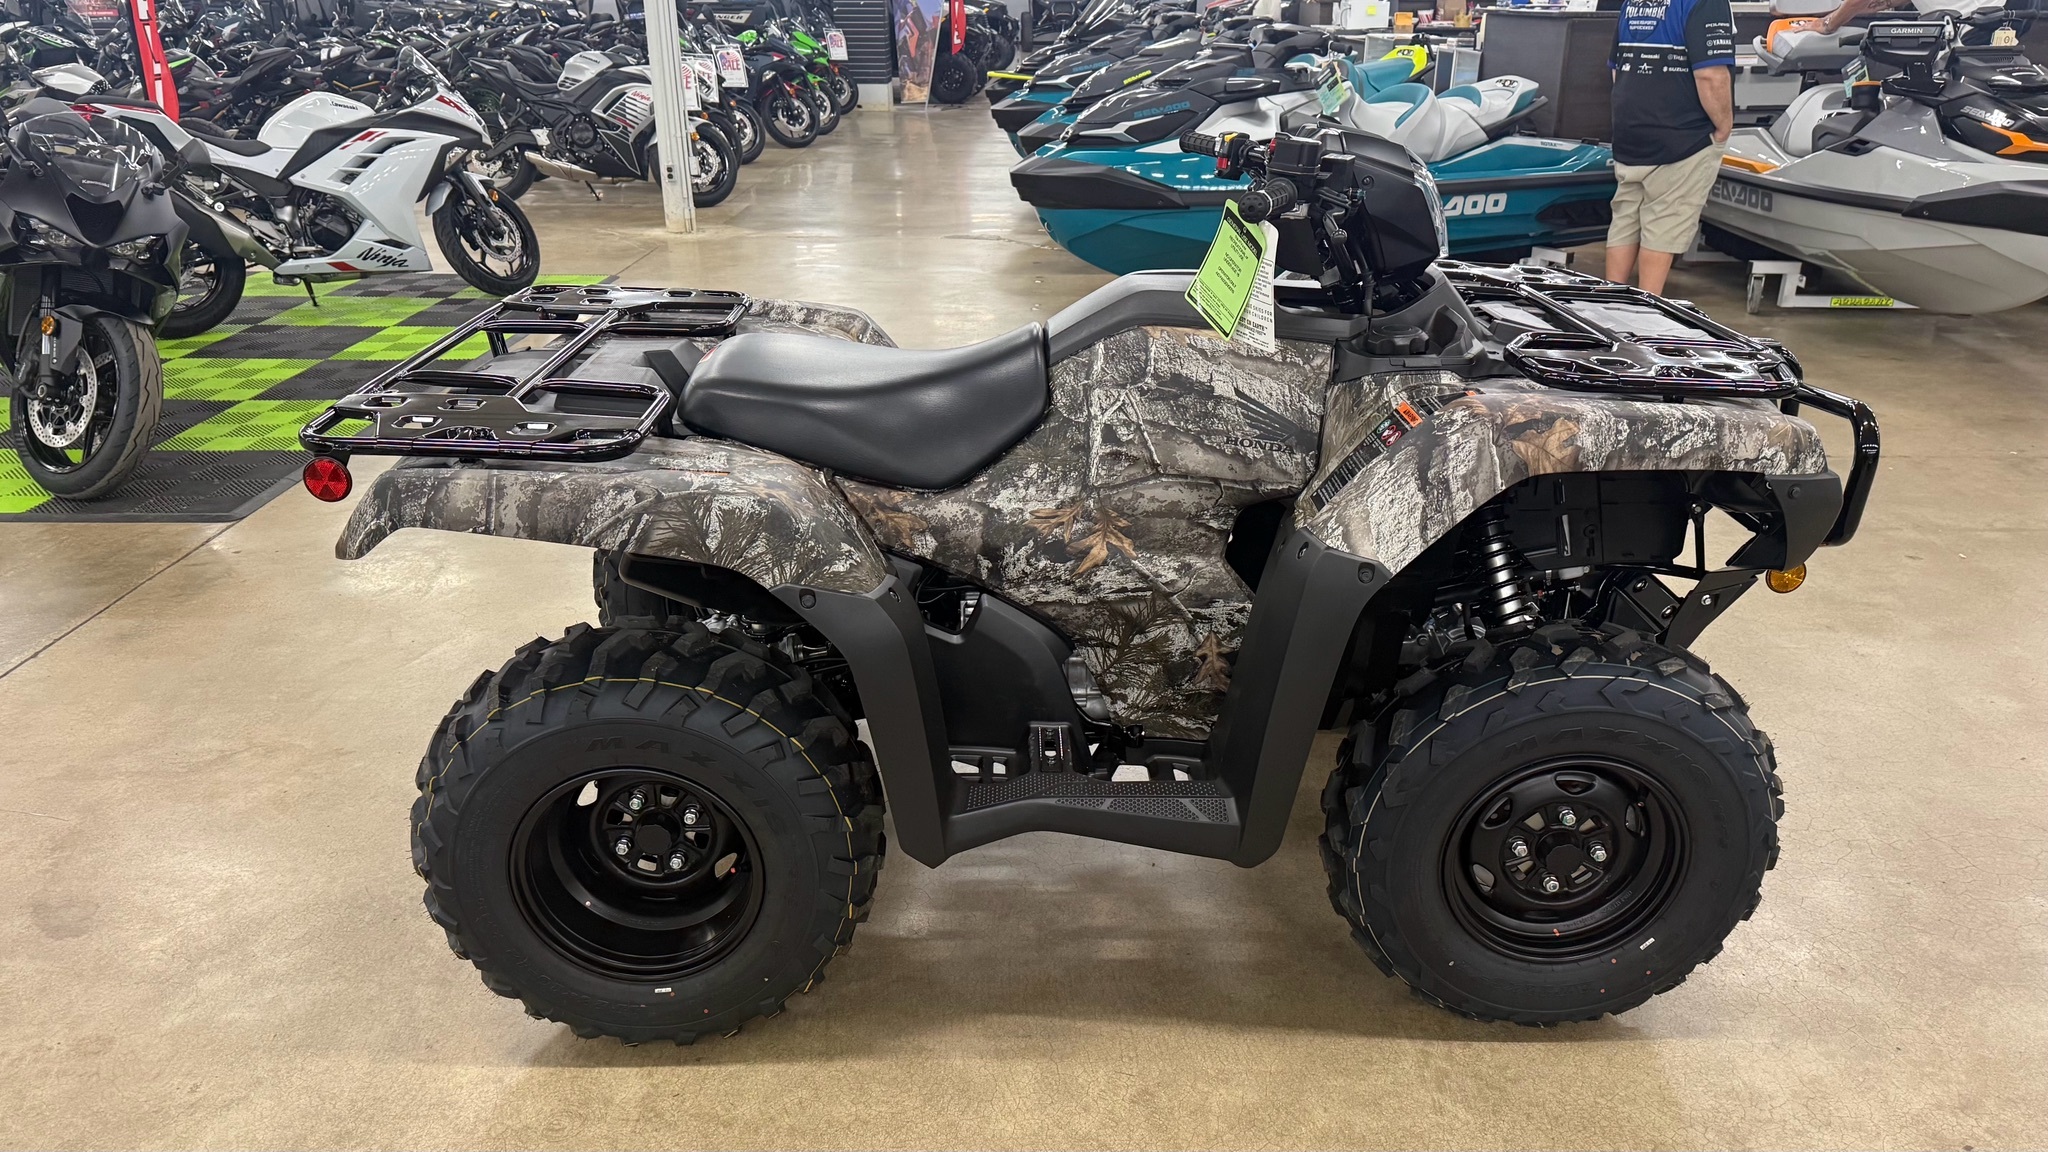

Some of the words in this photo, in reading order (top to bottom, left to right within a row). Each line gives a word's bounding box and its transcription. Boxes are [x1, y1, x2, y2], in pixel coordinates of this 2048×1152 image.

[722, 59, 741, 71] SALE
[330, 100, 359, 111] Kawasaki
[356, 246, 409, 268] Ninja
[1225, 435, 1295, 455] HONDA
[1501, 726, 1713, 786] MAXXIS
